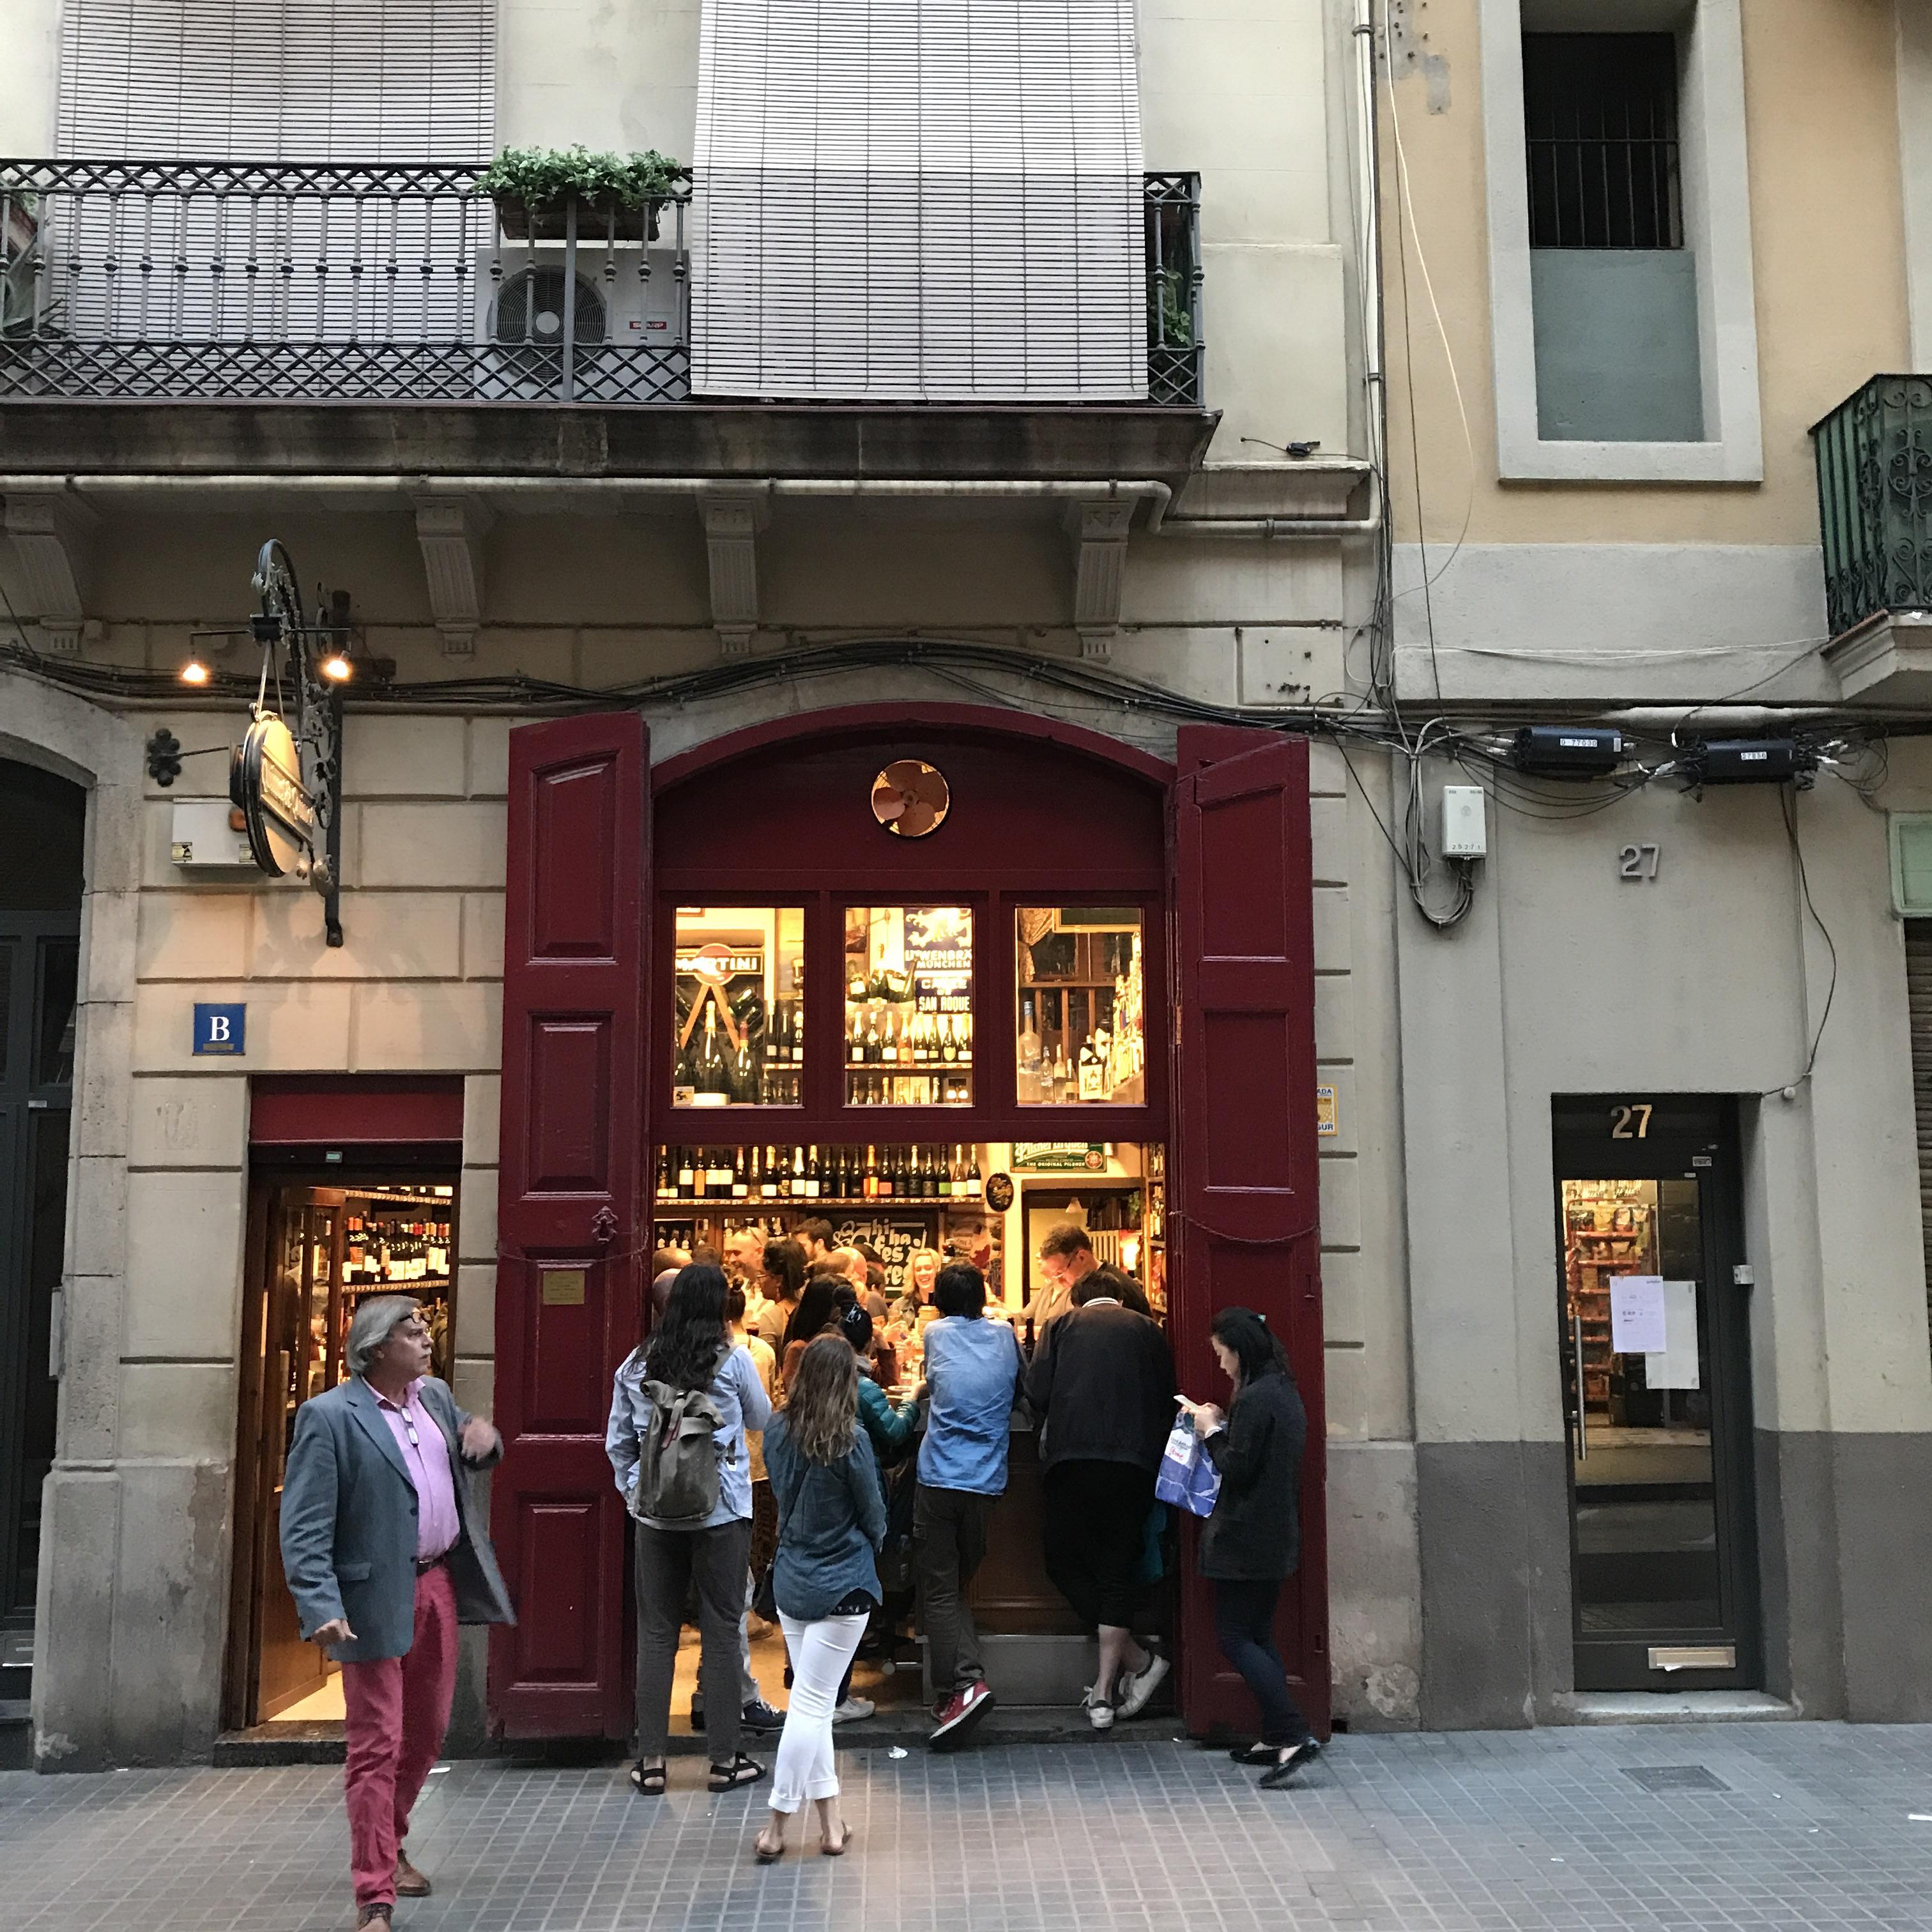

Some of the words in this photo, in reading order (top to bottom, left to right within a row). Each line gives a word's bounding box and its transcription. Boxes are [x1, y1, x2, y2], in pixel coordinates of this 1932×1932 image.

[1620, 843, 1660, 877] 27
[675, 957, 757, 971] MARTINI
[905, 949, 972, 961] LÖWENBRÄ
[919, 996, 937, 1011] SAN
[940, 996, 970, 1012] ROQUE
[209, 1016, 230, 1041] B
[1611, 1104, 1652, 1138] 27
